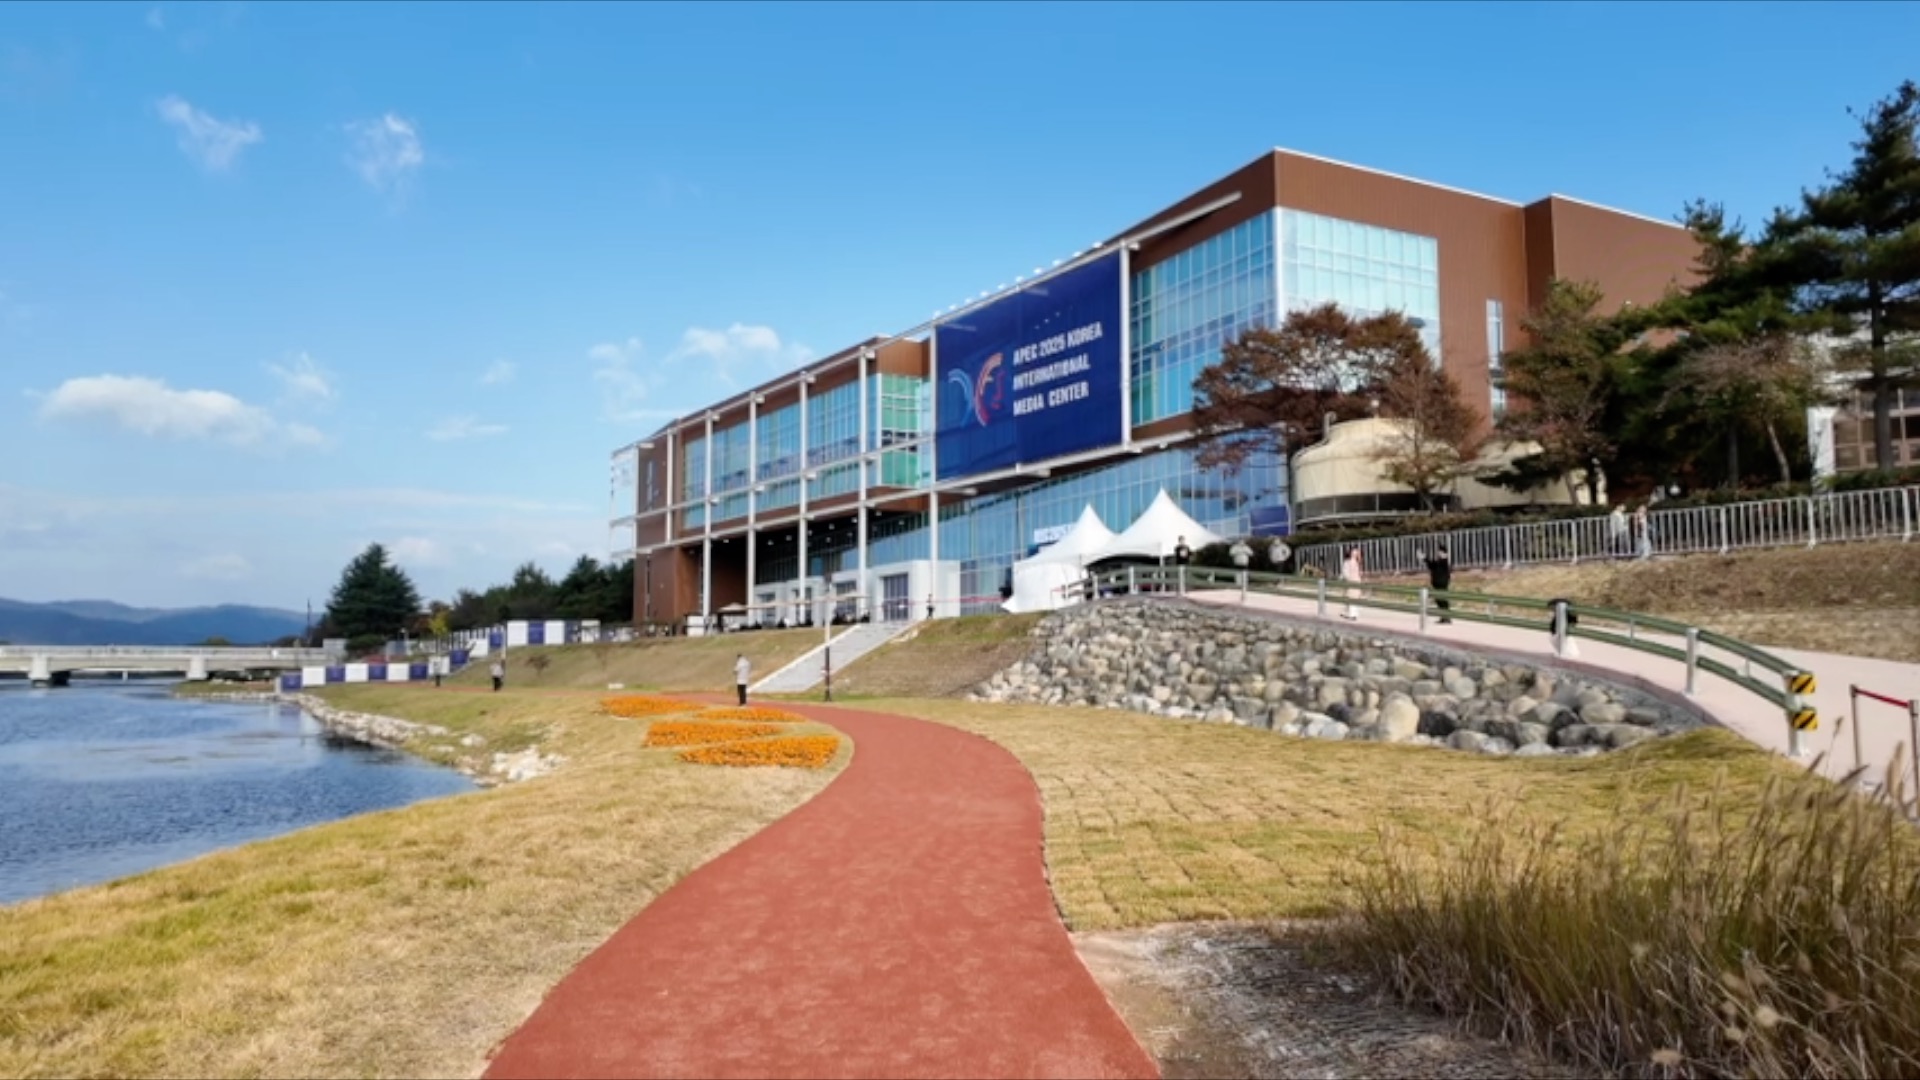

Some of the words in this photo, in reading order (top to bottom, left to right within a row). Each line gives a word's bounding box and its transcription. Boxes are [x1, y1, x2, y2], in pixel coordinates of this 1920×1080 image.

[1013, 343, 1038, 366] APEC
[1039, 332, 1066, 357] 2025
[1067, 321, 1103, 348] KOREA
[1013, 353, 1091, 391] INTERNATIONAL
[1013, 393, 1045, 416] MEDIA
[1049, 381, 1089, 408] CENTER
